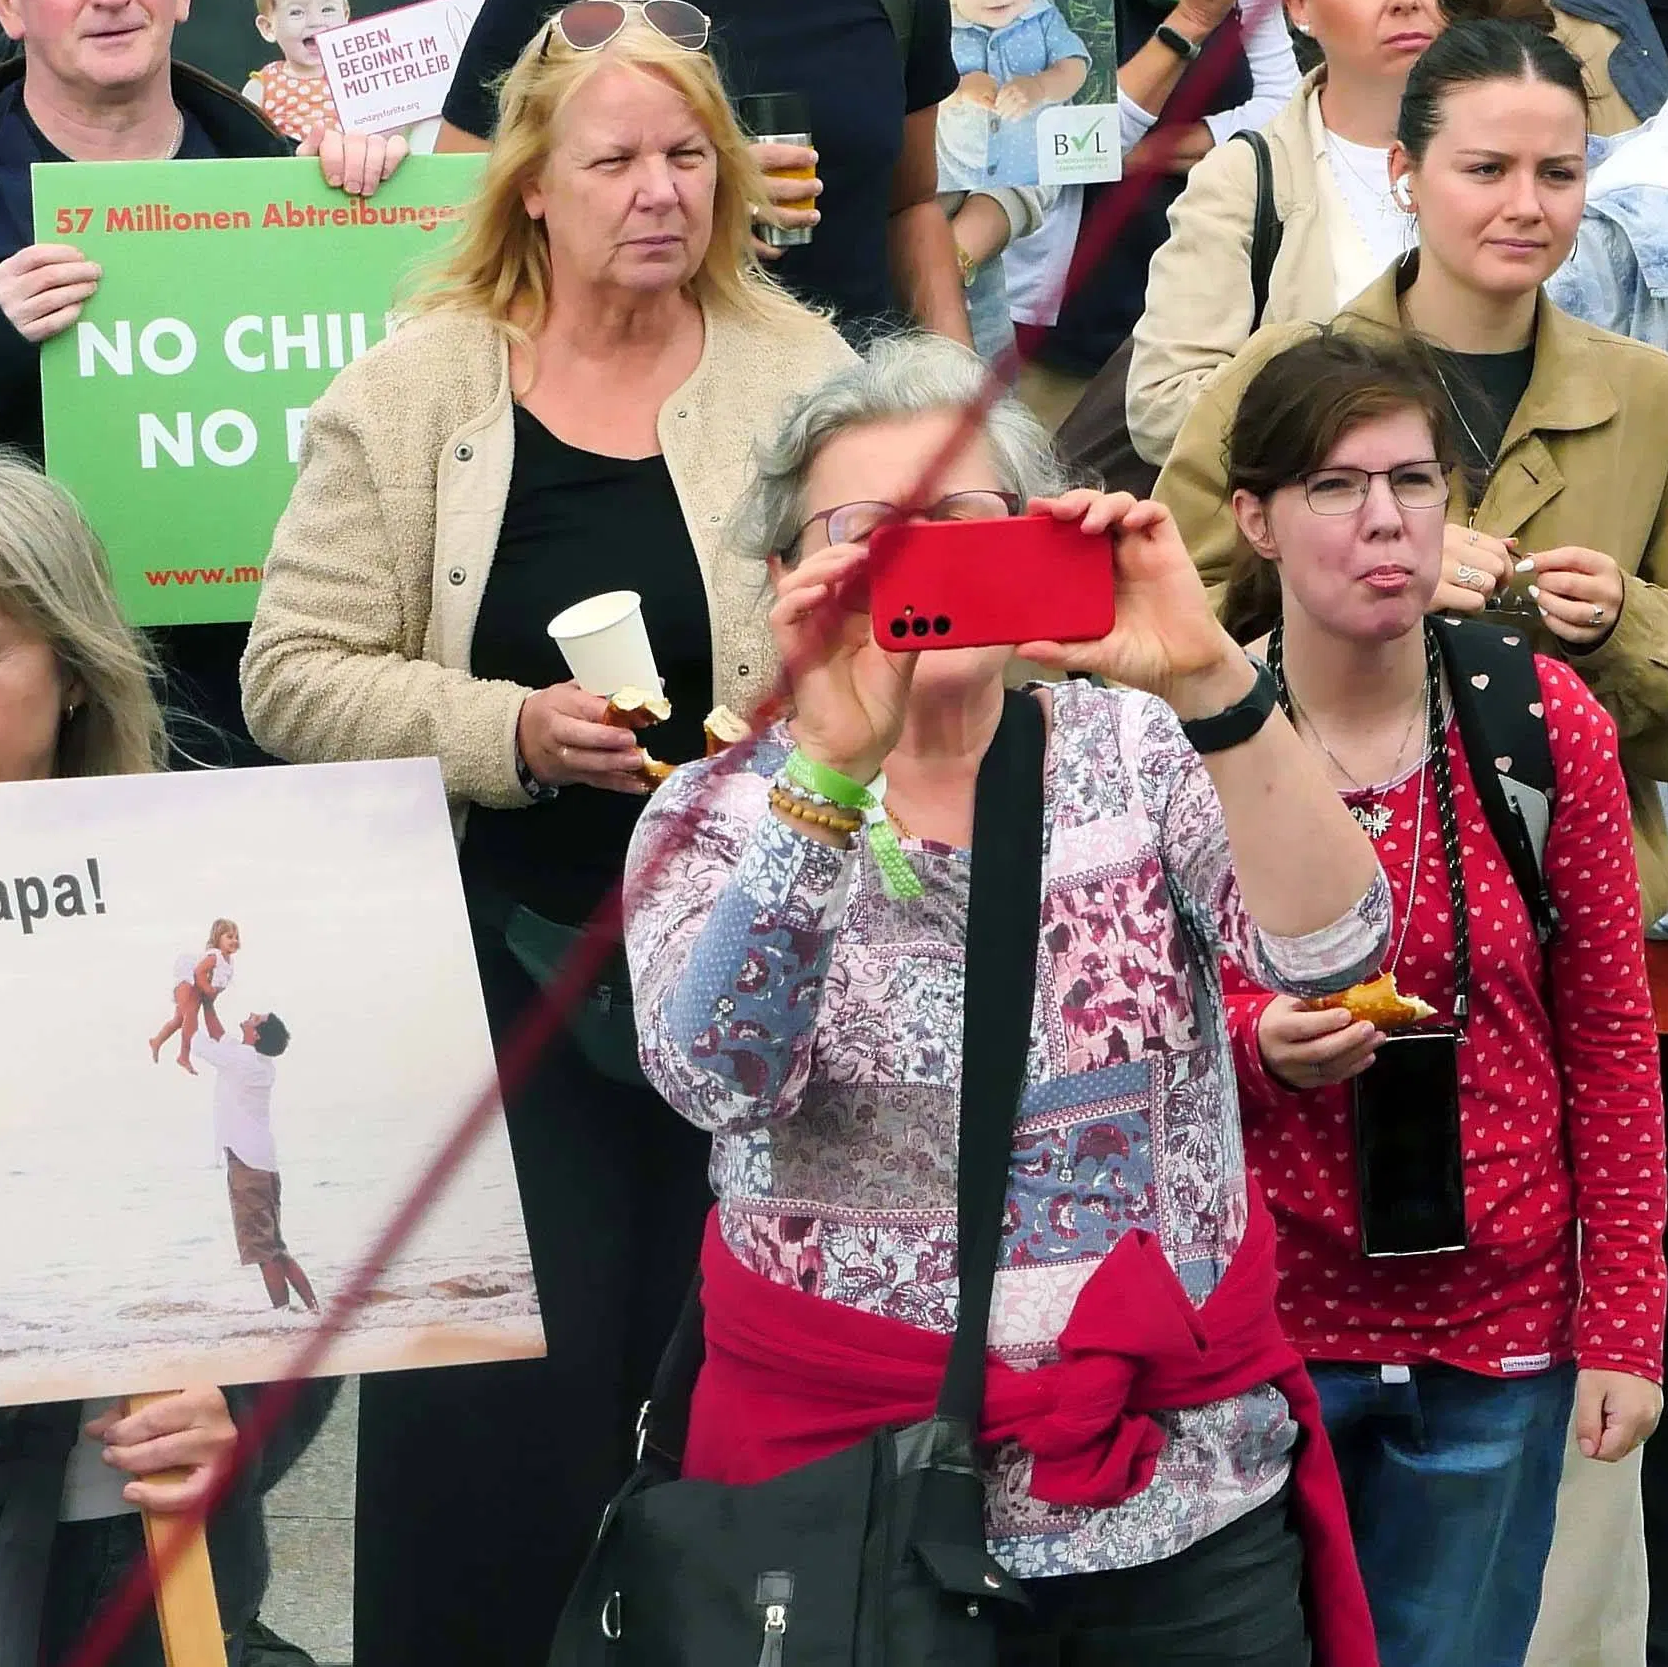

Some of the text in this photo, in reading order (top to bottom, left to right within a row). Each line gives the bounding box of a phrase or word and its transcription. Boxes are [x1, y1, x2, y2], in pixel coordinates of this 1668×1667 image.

[331, 27, 392, 60] LEBEN
[337, 34, 438, 80] BEGINNT IM
[342, 52, 451, 100] MUTTERLEIB
[54, 203, 251, 234] 57 Millionen
[76, 316, 198, 379] NO
[137, 408, 259, 470] NO
